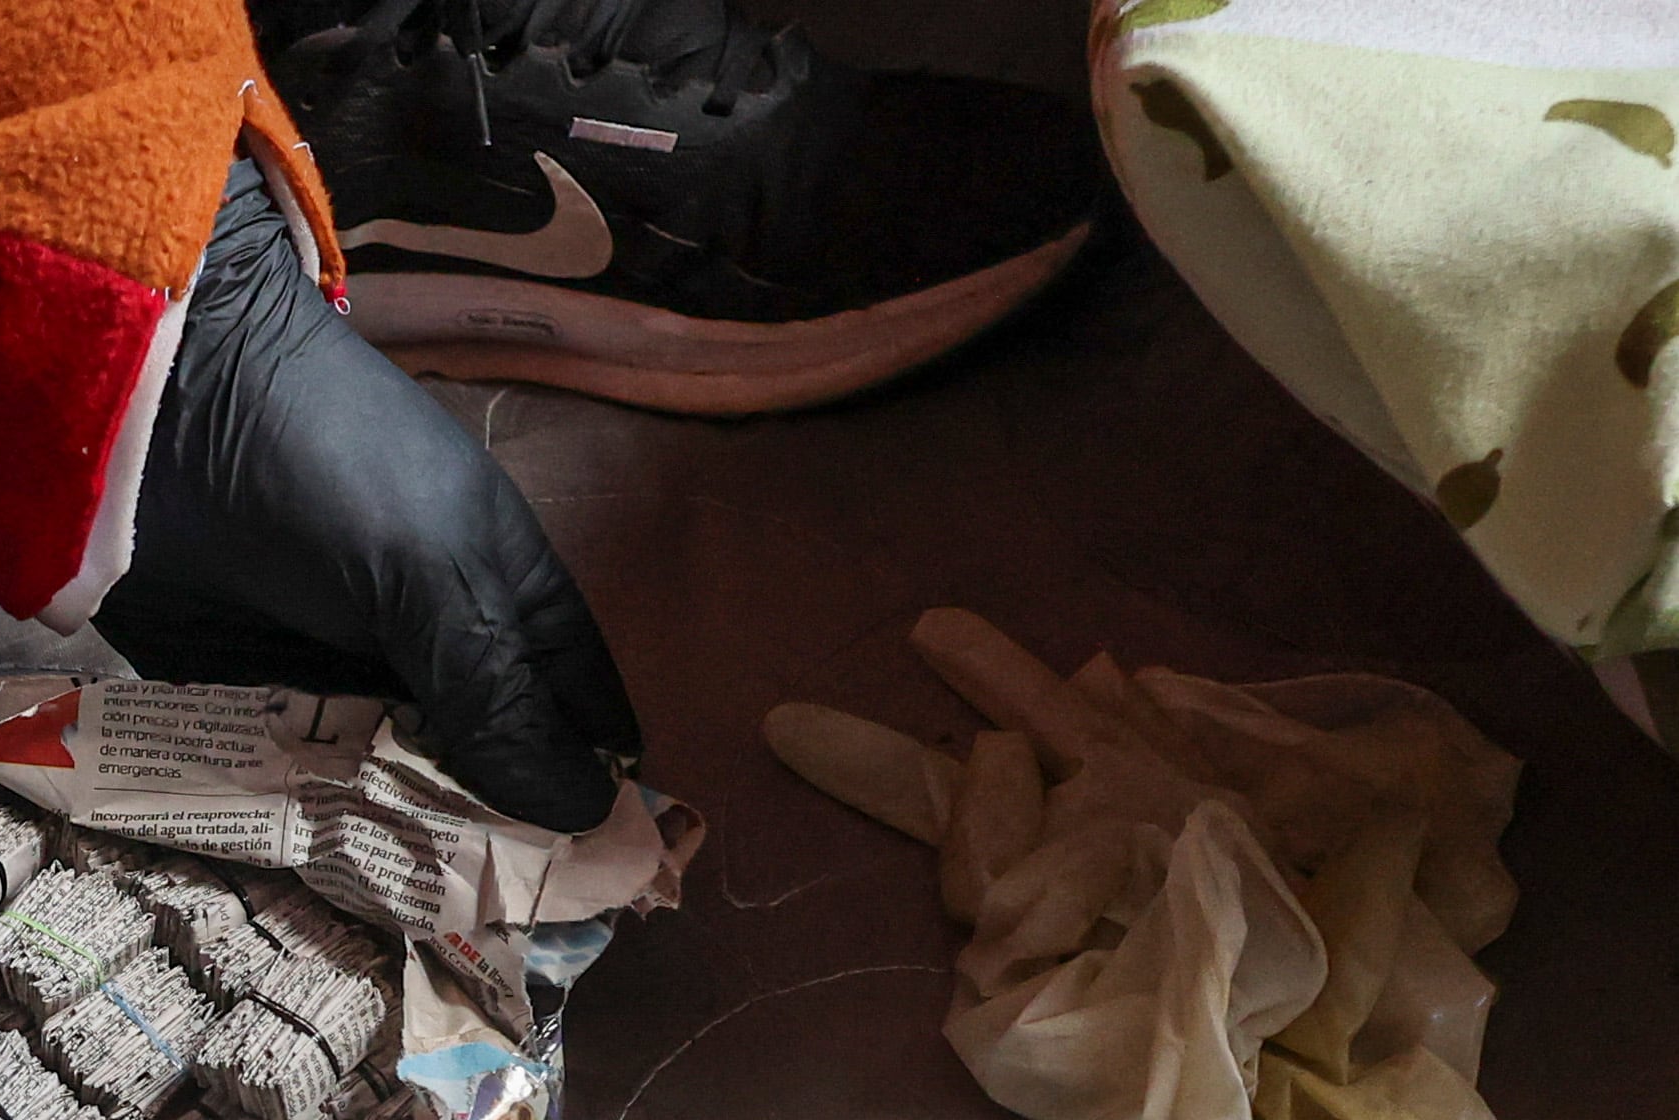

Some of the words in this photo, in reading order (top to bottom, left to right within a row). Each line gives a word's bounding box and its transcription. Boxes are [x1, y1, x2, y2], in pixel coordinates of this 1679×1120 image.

[233, 704, 259, 718] info
[182, 718, 190, 730] y
[101, 726, 112, 738] la
[115, 729, 172, 745] empresa
[174, 736, 213, 750] podrá
[216, 740, 256, 753] actuar
[100, 744, 116, 756] de
[120, 747, 169, 760] manera
[173, 751, 232, 768] oportuna
[235, 758, 263, 768] ante
[91, 810, 169, 823] incorporará
[173, 811, 185, 821] el
[187, 810, 275, 823] reaprovecha-
[137, 823, 158, 836] del
[161, 825, 192, 839] agua
[196, 823, 248, 836] tratada,
[251, 823, 273, 834] ali-
[202, 840, 218, 851] de
[221, 839, 271, 853] gestión
[350, 822, 367, 833] de
[369, 825, 389, 841] los
[443, 851, 456, 865] y
[351, 837, 370, 852] las
[370, 847, 412, 867] partes
[363, 858, 376, 872] la
[378, 867, 445, 895] protección
[371, 883, 440, 913] subsistema
